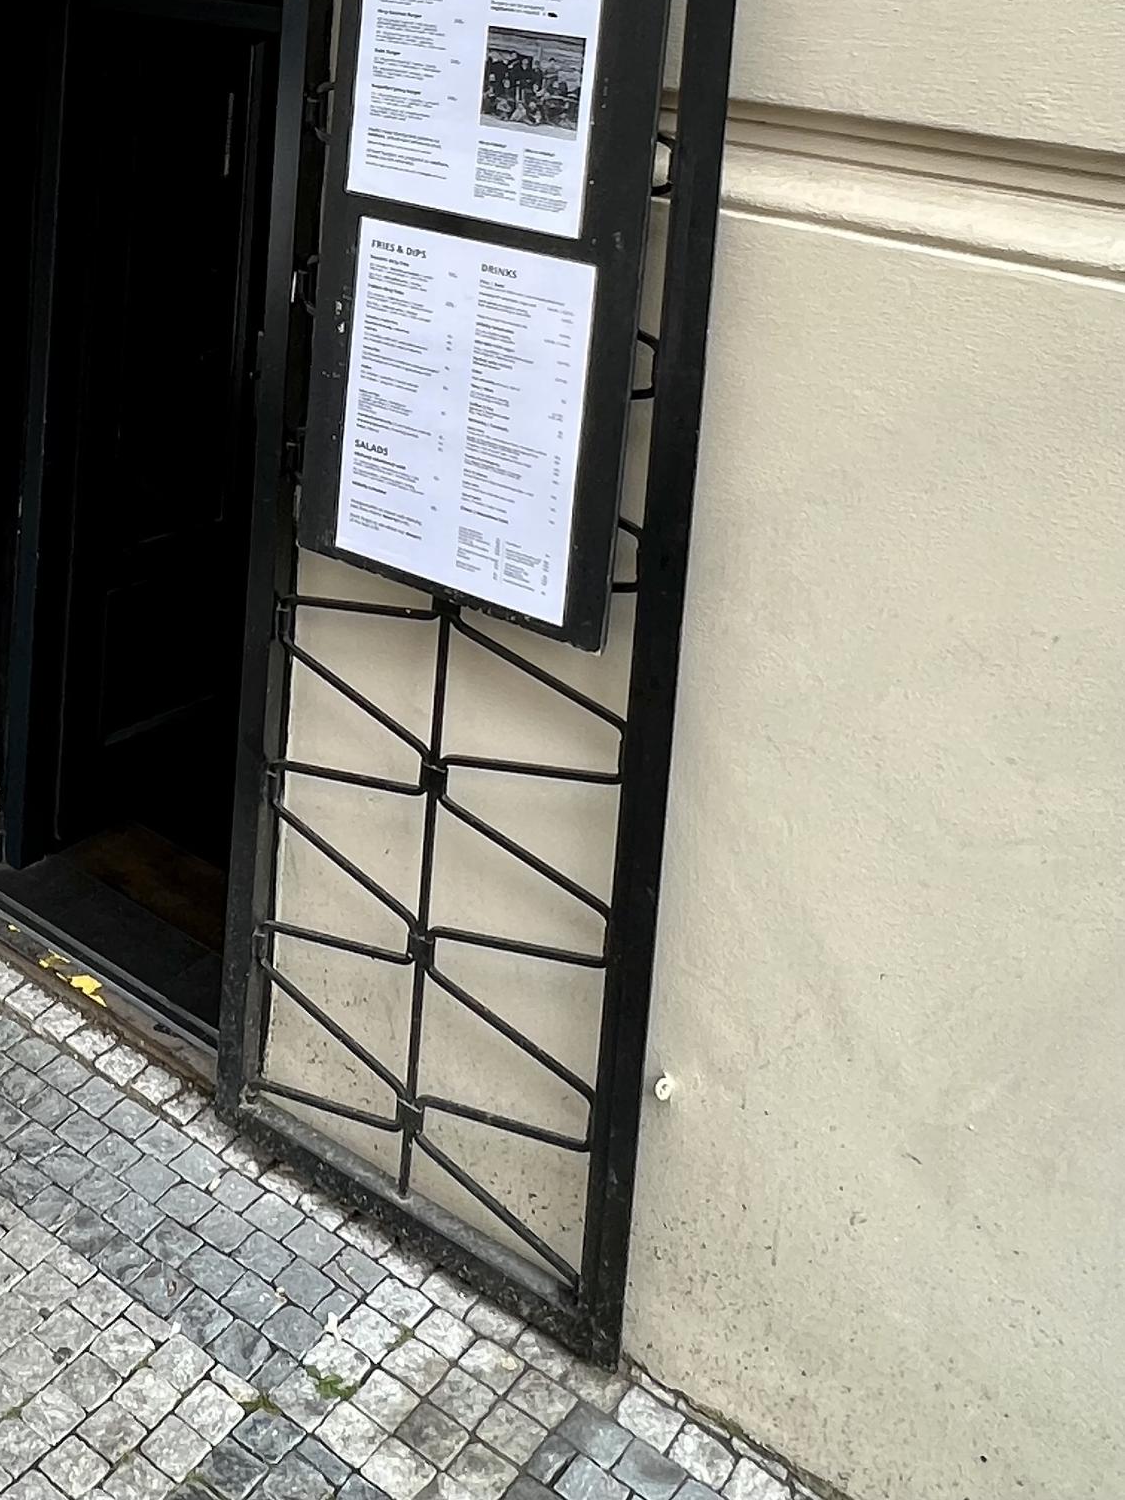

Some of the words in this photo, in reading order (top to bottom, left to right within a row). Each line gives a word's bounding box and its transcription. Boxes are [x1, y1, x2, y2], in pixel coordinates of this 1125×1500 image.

[371, 239, 396, 252] FRIES
[396, 245, 405, 254] &
[406, 247, 427, 259] DIPS
[481, 263, 518, 279] DRINKS
[354, 439, 389, 456] SALADS
